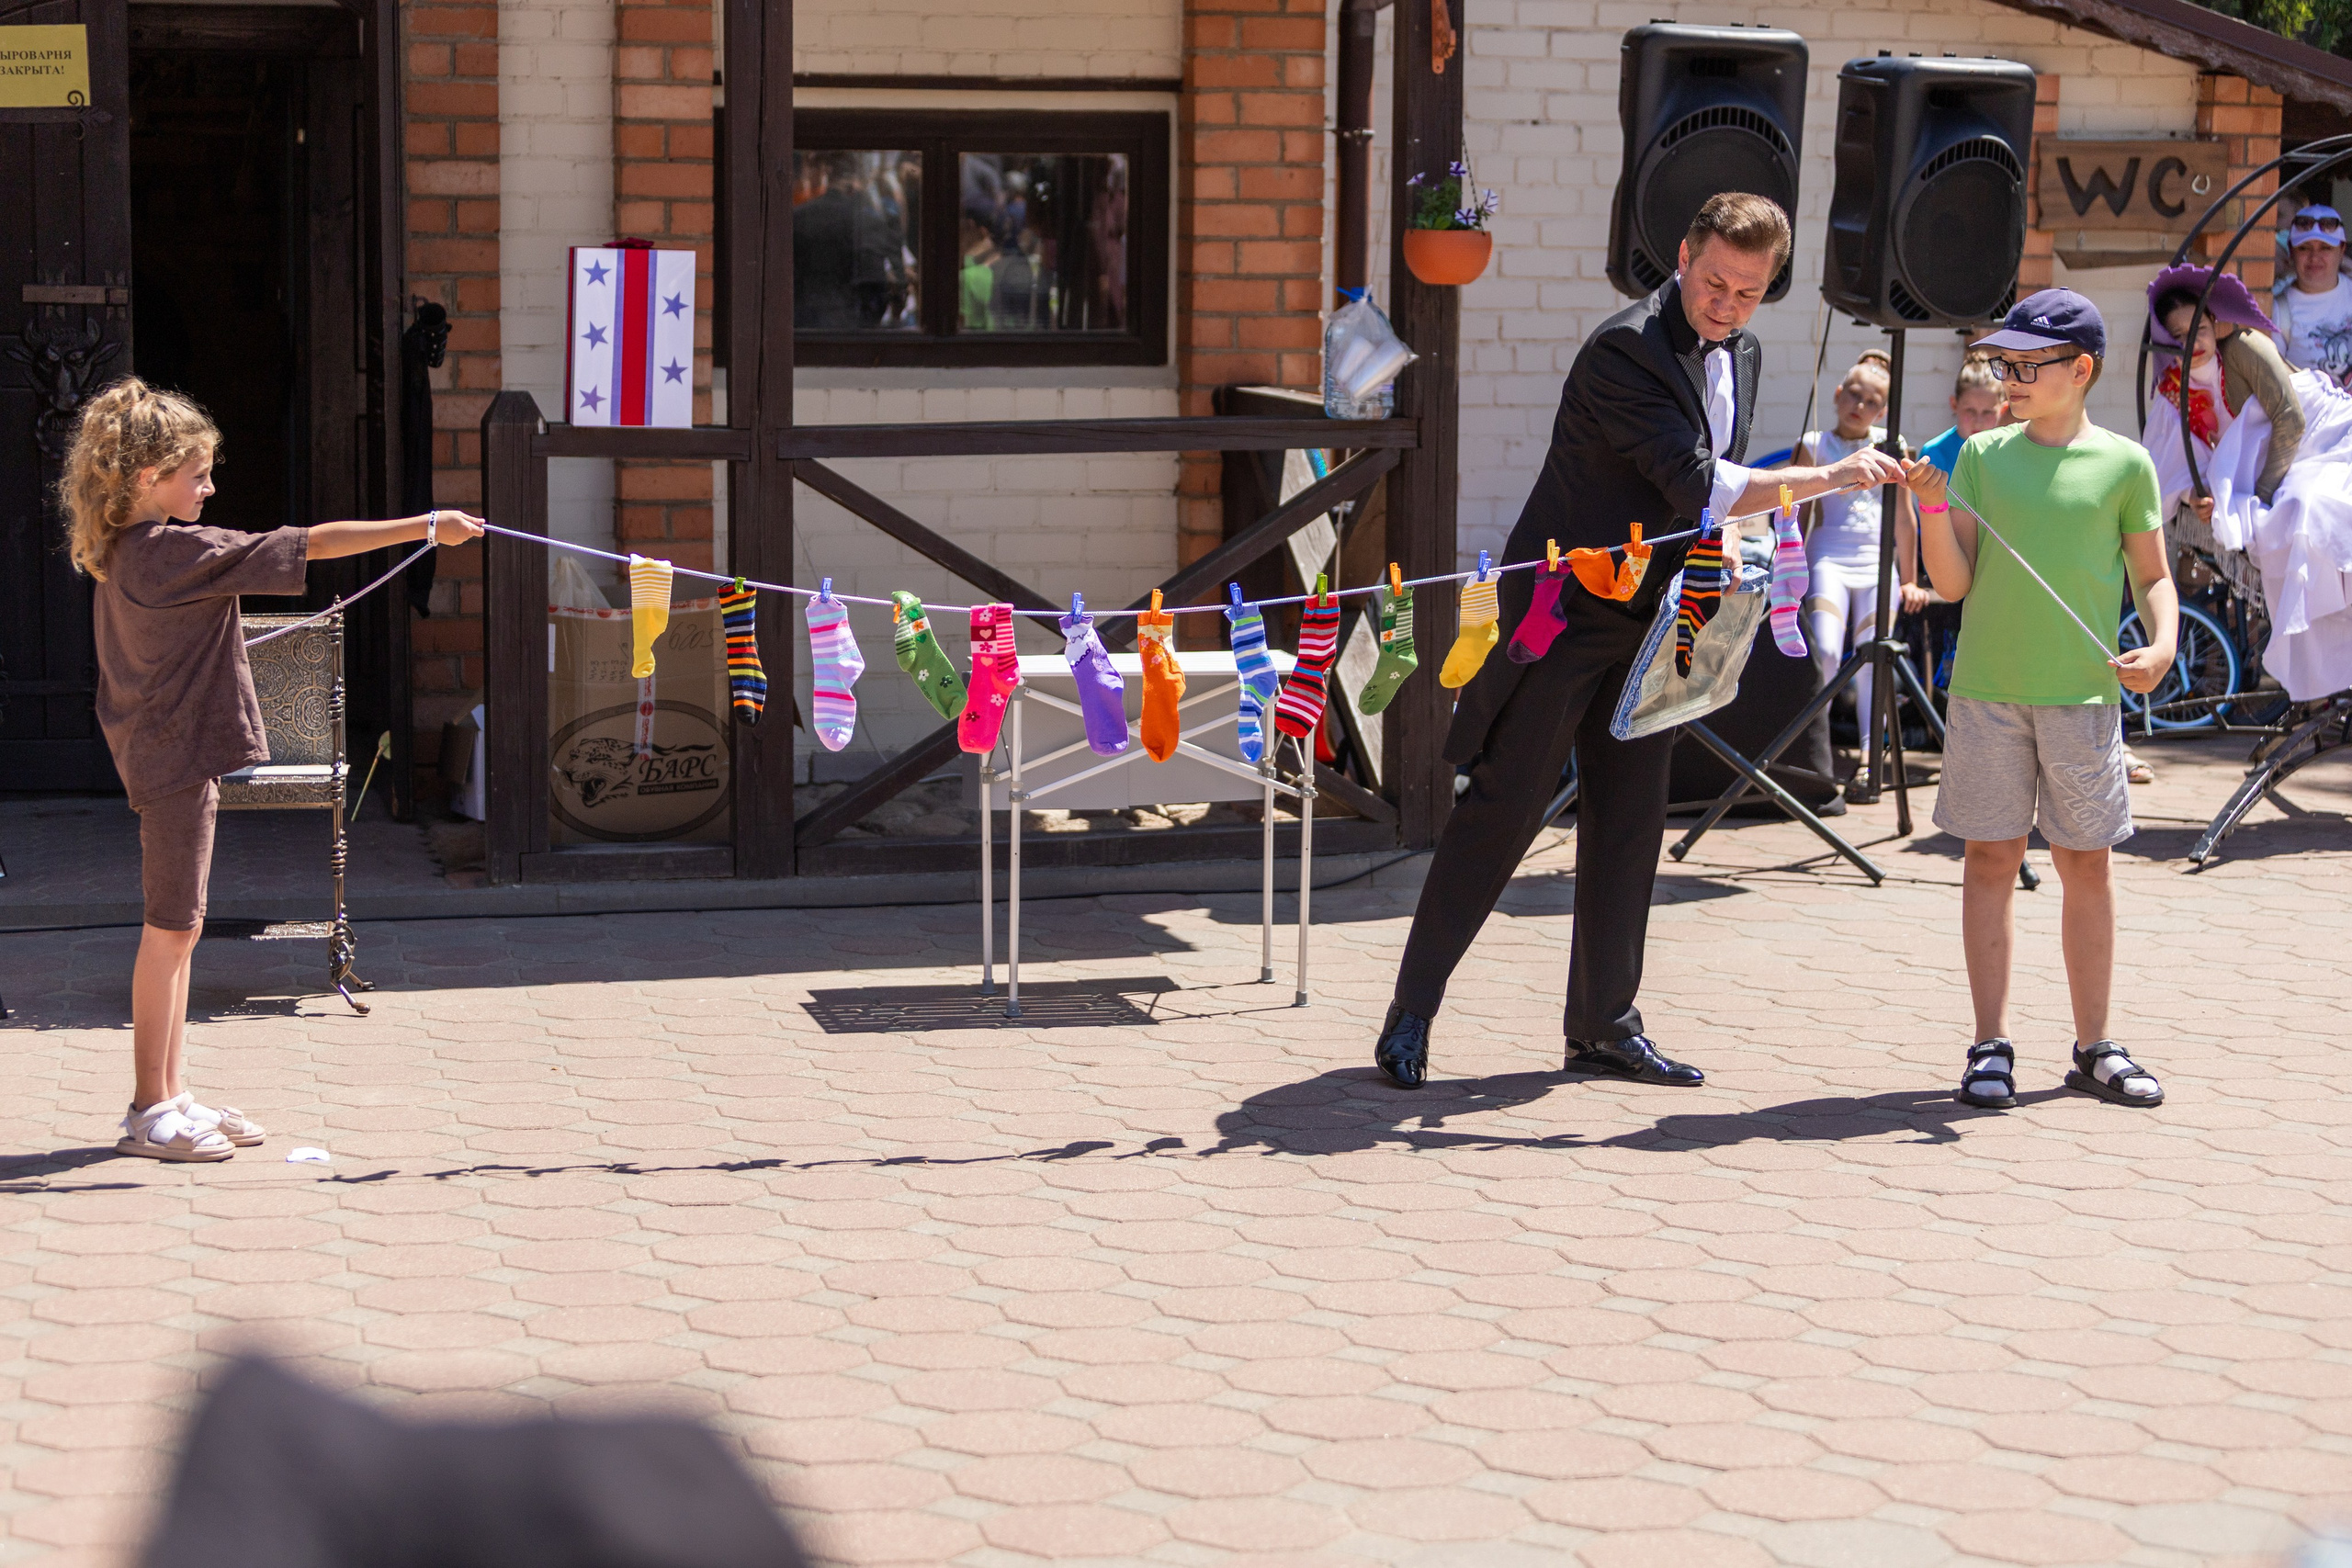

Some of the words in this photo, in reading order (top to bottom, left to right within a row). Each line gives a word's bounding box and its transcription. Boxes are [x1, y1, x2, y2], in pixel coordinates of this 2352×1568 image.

[0, 65, 64, 74] ЗАКРЫТА!
[2056, 156, 2188, 218] WC
[639, 754, 717, 783] БАРС
[639, 784, 674, 793] ОБУВНАЯ
[676, 780, 717, 790] КОМПАНИЯ
